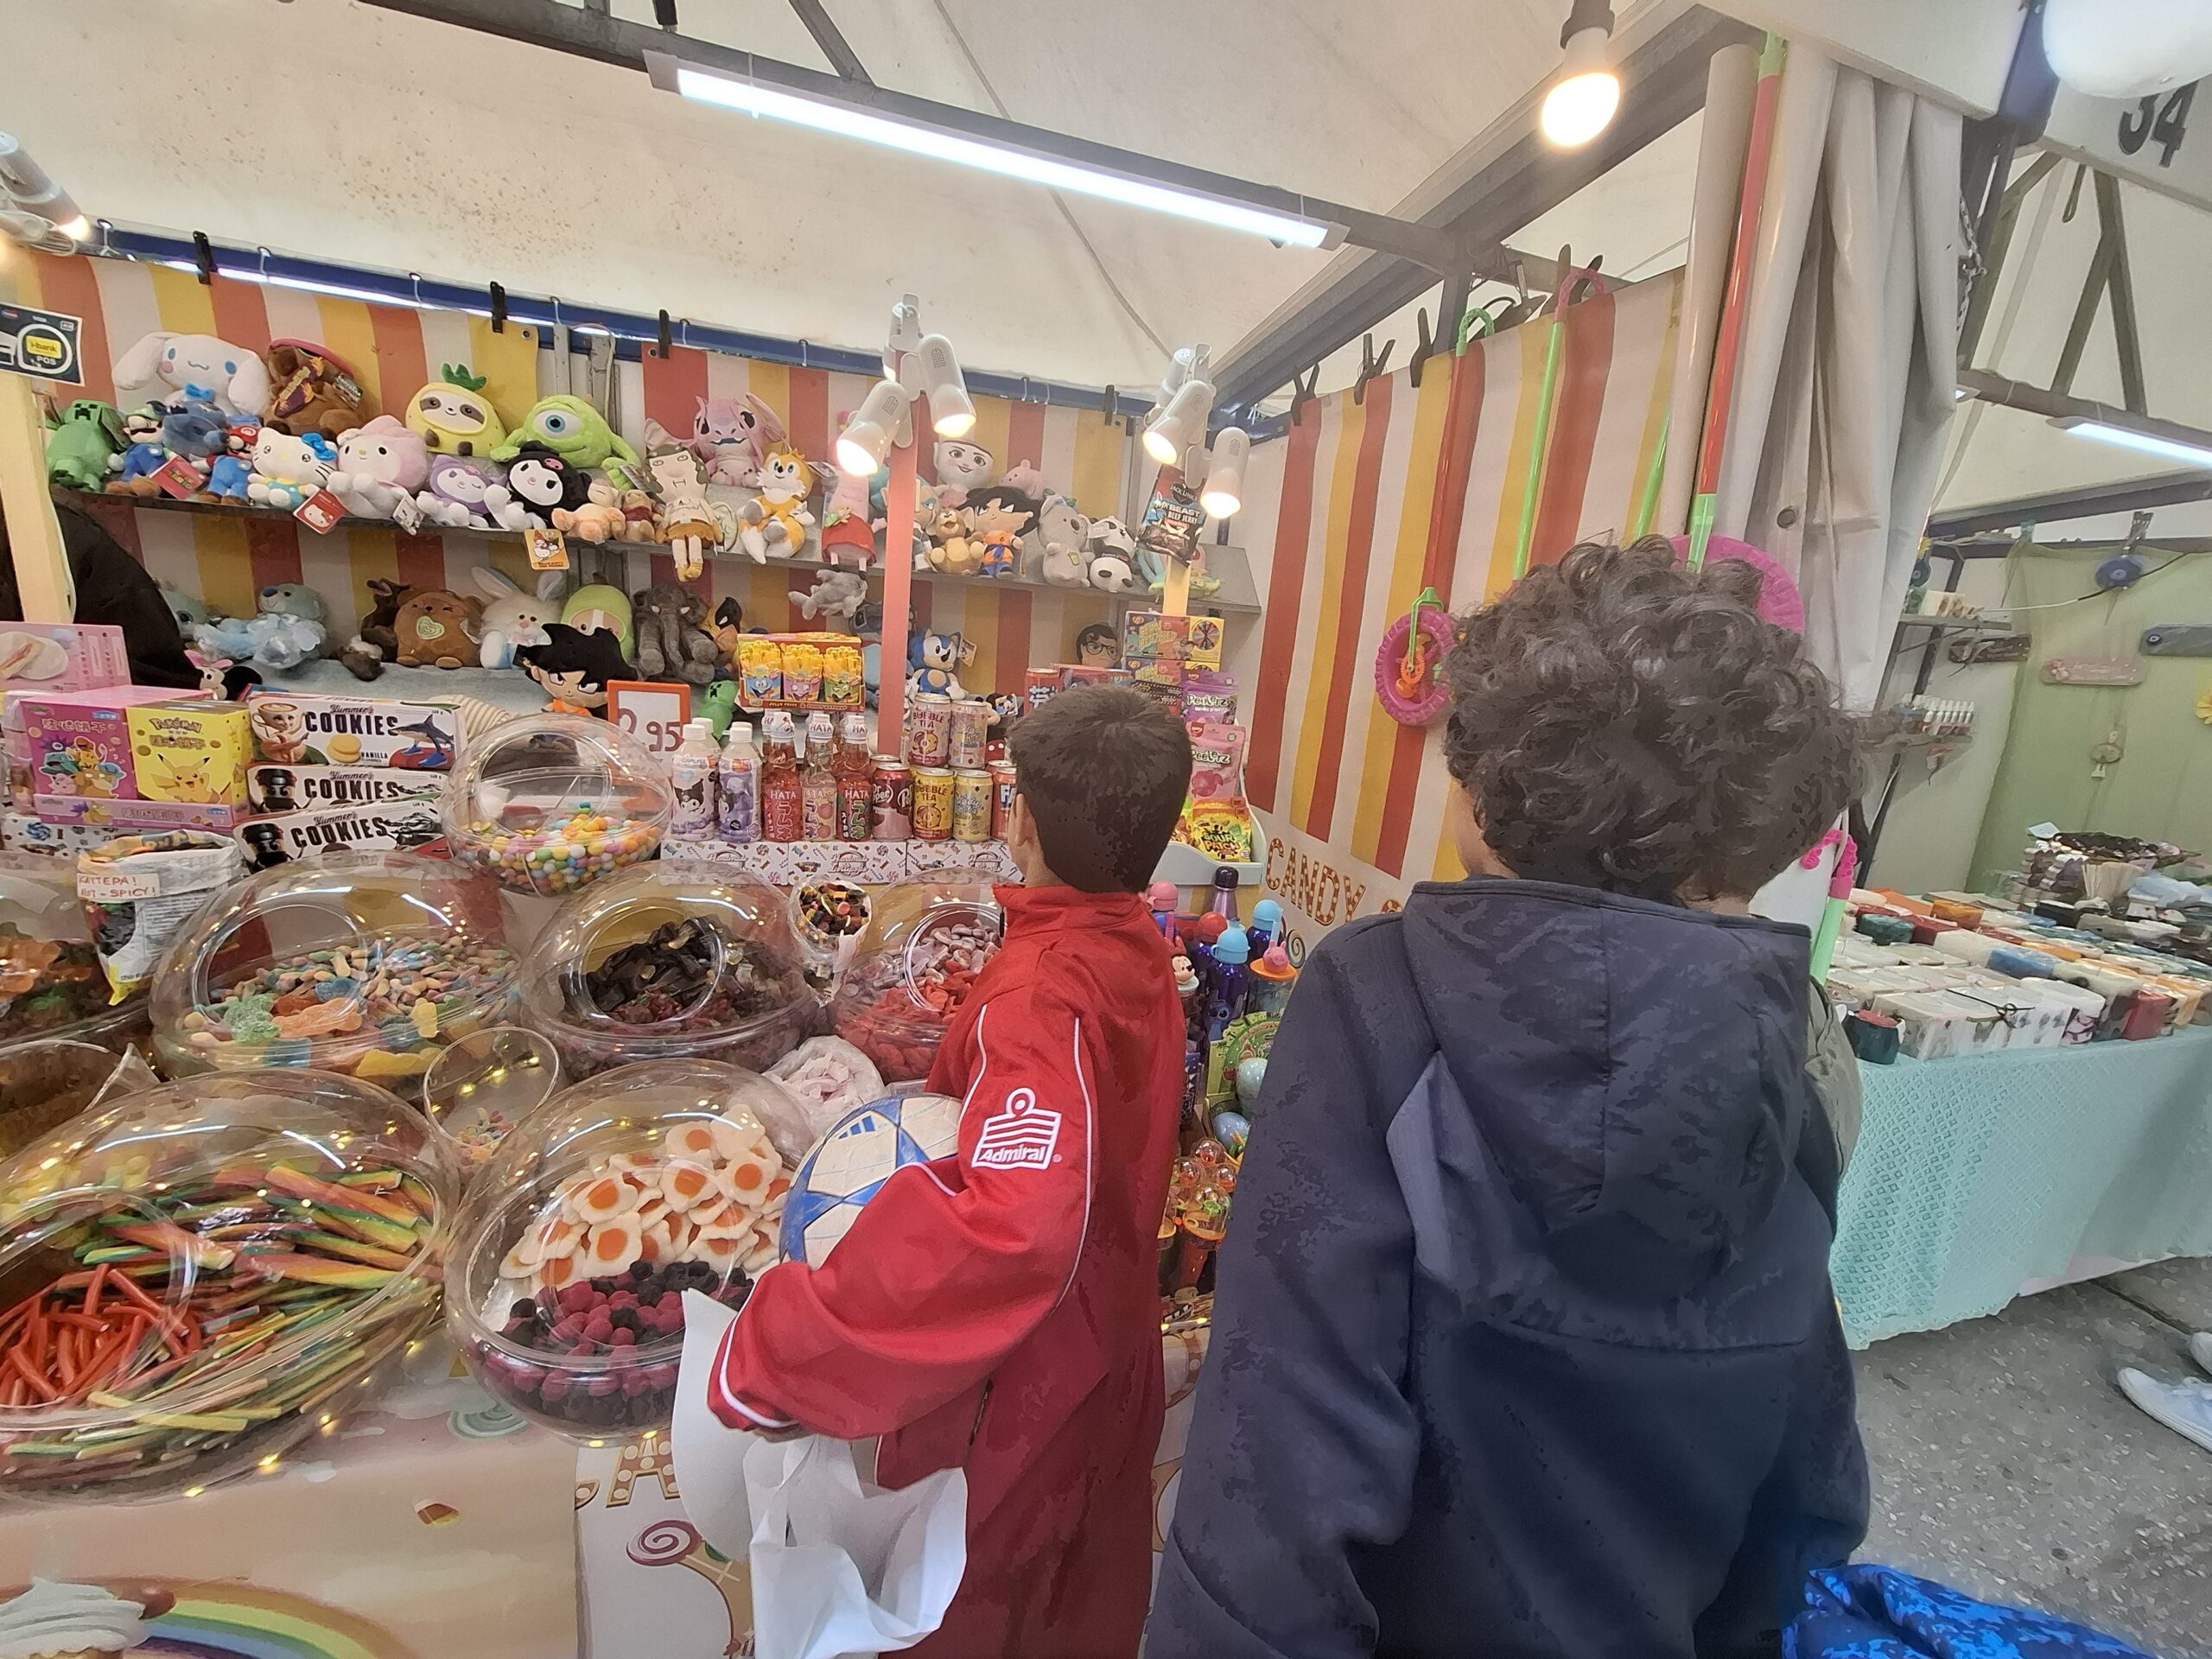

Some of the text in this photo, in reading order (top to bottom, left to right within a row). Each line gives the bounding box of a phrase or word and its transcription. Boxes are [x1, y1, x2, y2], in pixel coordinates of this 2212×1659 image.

[36, 355, 57, 365] POS
[913, 710, 945, 723] BUBBLE
[305, 712, 399, 736] COOKIES
[304, 779, 398, 800] COOKIES
[771, 789, 797, 800] HATA
[845, 789, 869, 799] HATA
[915, 785, 949, 796] BUBBLE
[922, 794, 938, 803] TEA
[290, 817, 390, 849] COOKIES
[1204, 831, 1236, 842] SOUR
[1204, 840, 1241, 850] PATCH
[1266, 837, 1367, 926] CANDY
[978, 1144, 1047, 1163] Admiral
